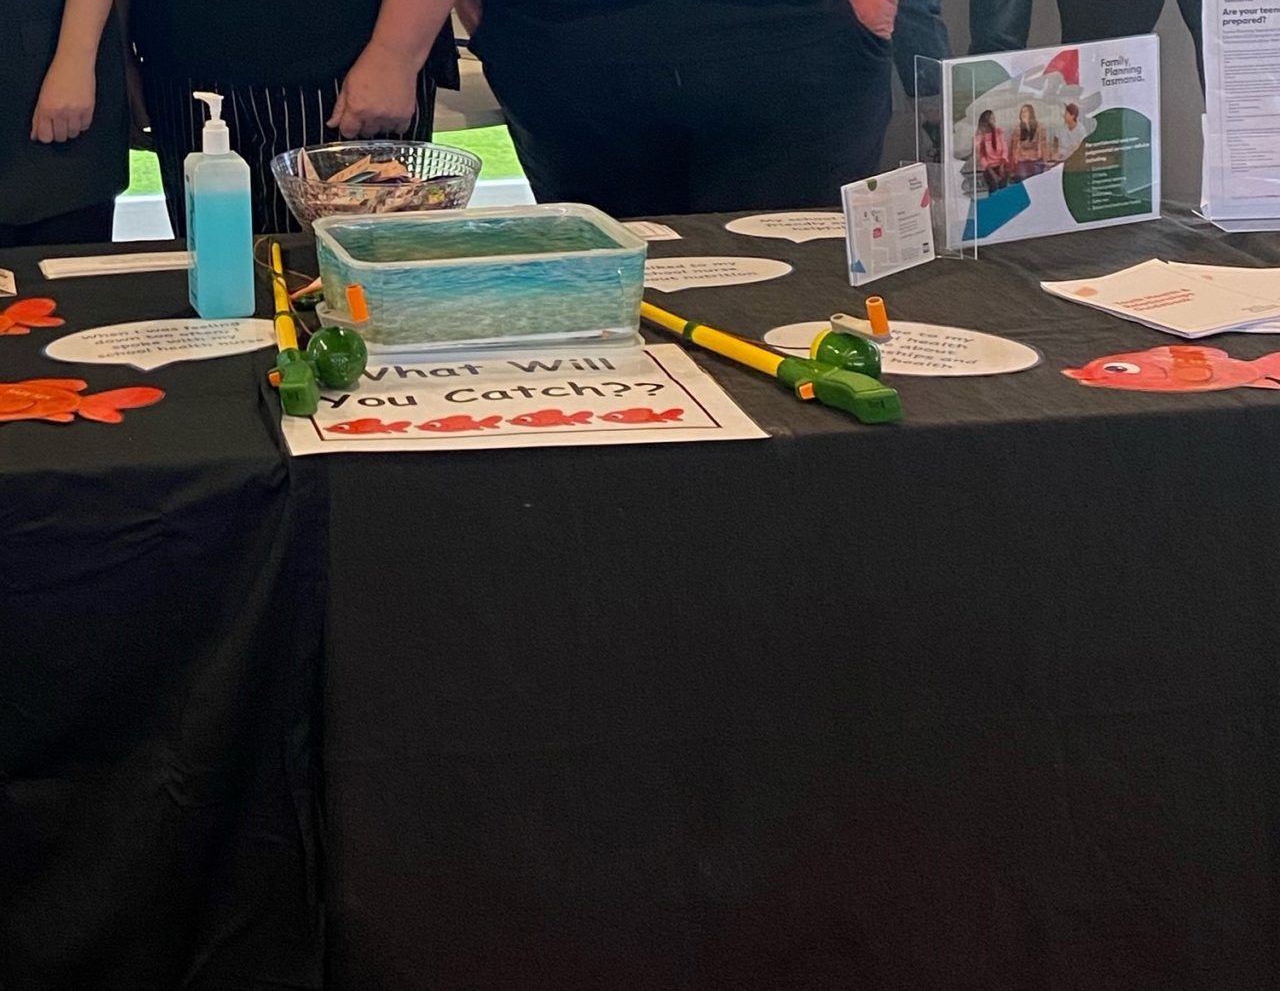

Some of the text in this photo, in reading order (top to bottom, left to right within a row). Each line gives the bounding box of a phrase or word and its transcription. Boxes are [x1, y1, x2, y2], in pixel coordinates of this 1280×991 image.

[1239, 9, 1258, 17] your
[1222, 16, 1266, 26] prepared?
[1104, 66, 1142, 77] Planning
[80, 331, 128, 339] When
[945, 335, 974, 343] my
[111, 340, 160, 348] spoke
[907, 337, 967, 349] health
[97, 349, 150, 357] school
[156, 341, 212, 351] health
[899, 344, 955, 354] about
[508, 357, 616, 373] Will
[891, 357, 952, 369] health
[939, 356, 977, 365] and
[444, 381, 665, 403] Catch??
